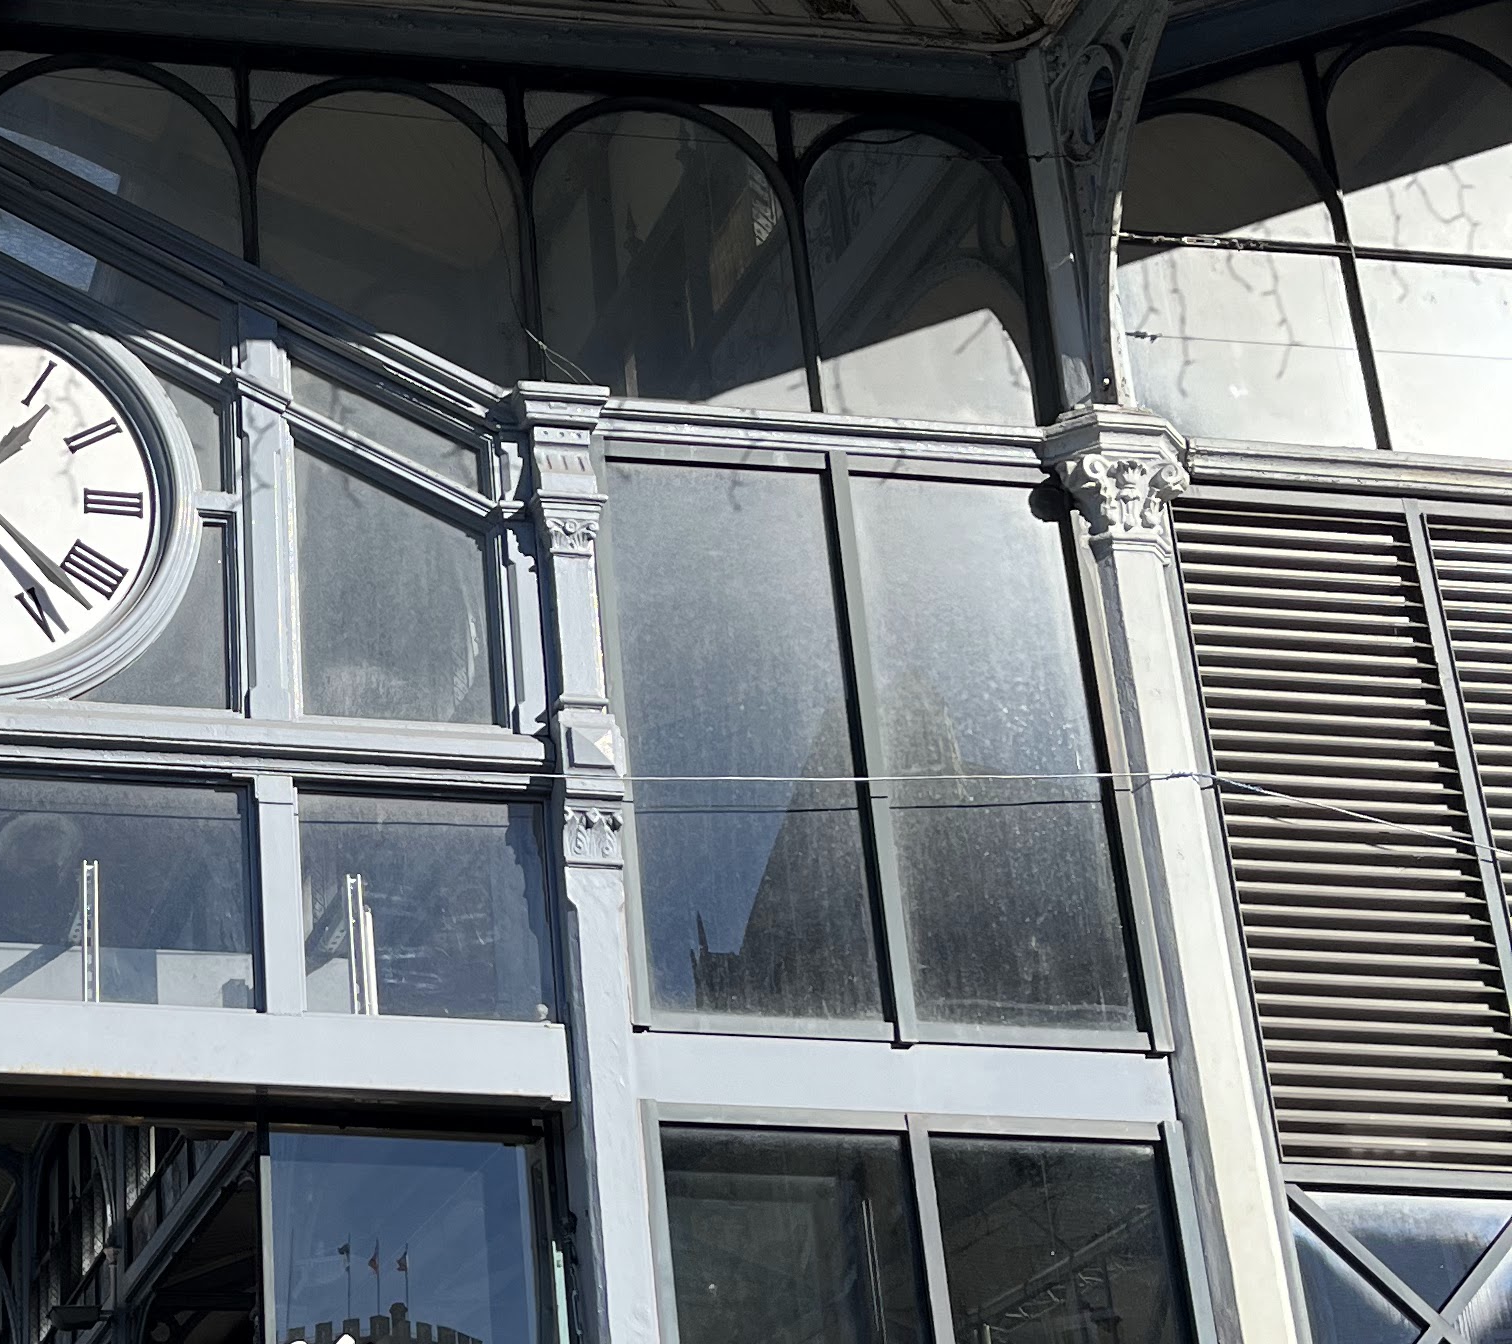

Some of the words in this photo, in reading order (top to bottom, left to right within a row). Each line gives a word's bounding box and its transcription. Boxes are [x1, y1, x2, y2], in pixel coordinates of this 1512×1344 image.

[21, 360, 58, 406] I
[64, 417, 123, 454] II
[84, 488, 144, 518] III
[60, 539, 129, 600] IIII
[14, 586, 56, 643] V
